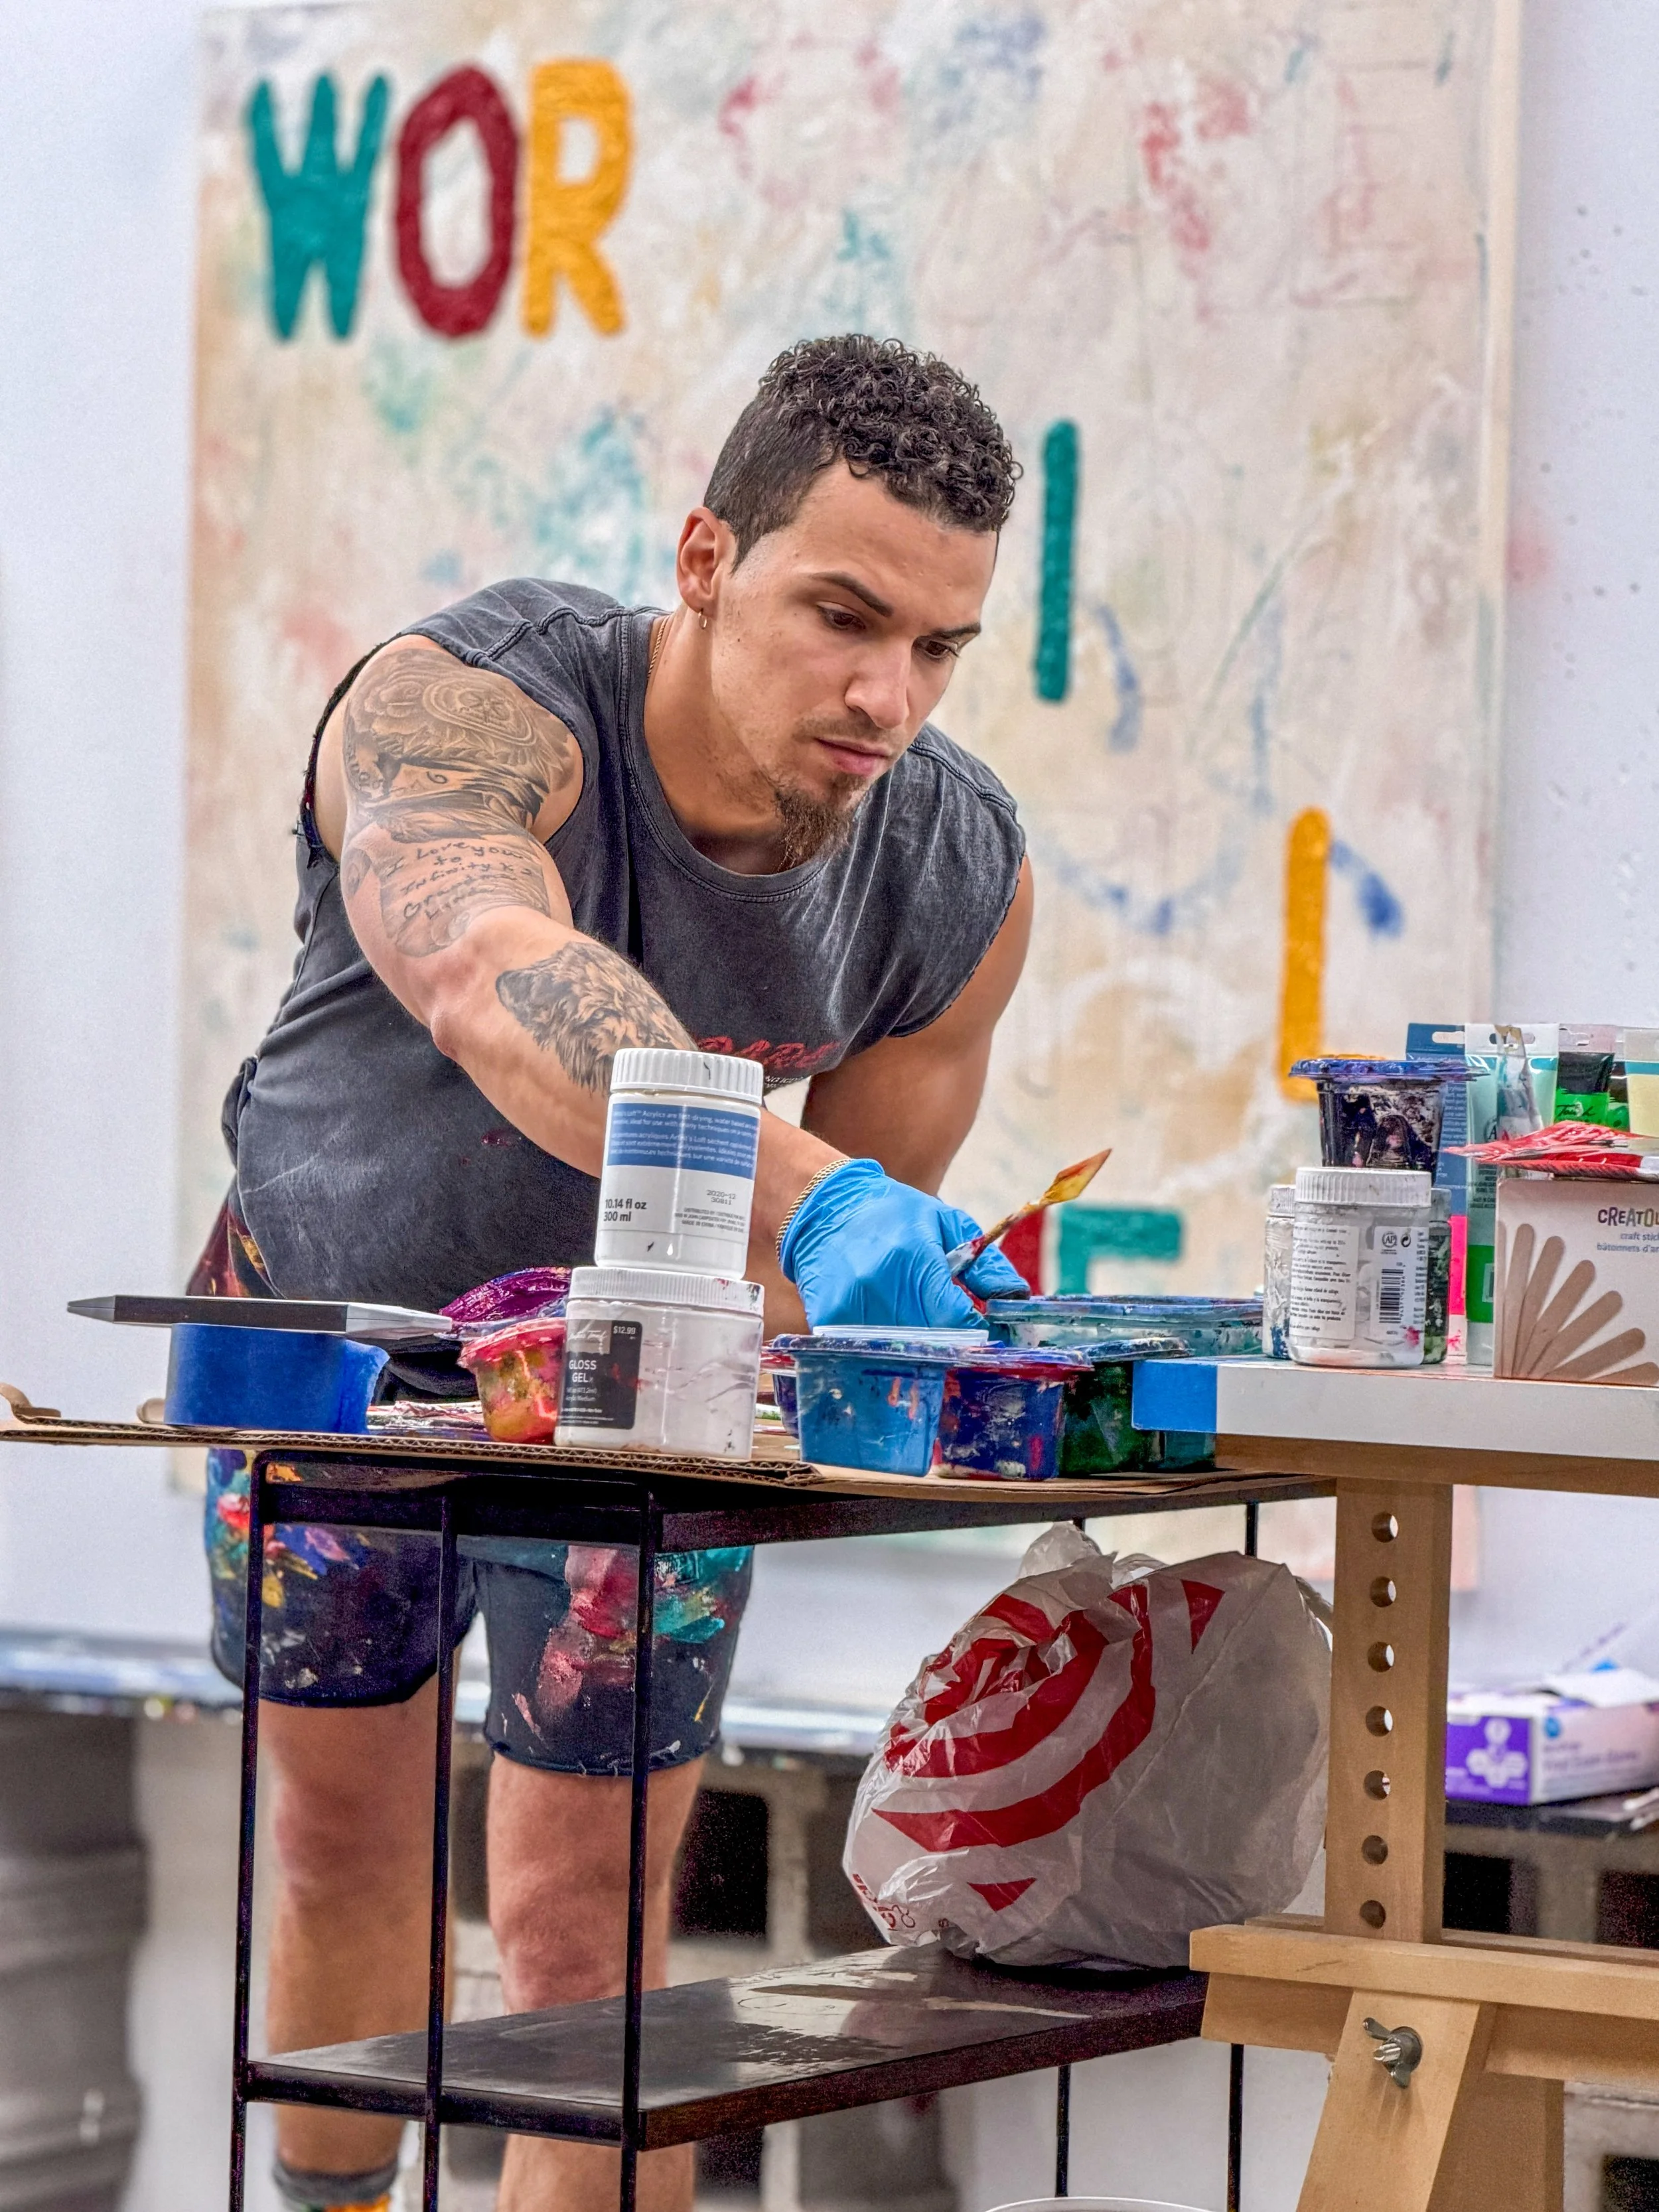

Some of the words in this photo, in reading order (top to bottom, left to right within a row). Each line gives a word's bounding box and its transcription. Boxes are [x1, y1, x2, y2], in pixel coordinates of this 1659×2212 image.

[244, 60, 634, 342] WOR
[416, 841, 470, 860] Love
[434, 855, 462, 865] to
[706, 1190, 736, 1200] 2020-12
[605, 1198, 623, 1210] 10.14
[625, 1199, 632, 1210] fl
[603, 1211, 618, 1221] 300
[619, 1211, 631, 1221] ml
[613, 1326, 636, 1335] $12.99
[568, 1359, 597, 1371] GLOSS
[571, 1372, 589, 1383] GEL
